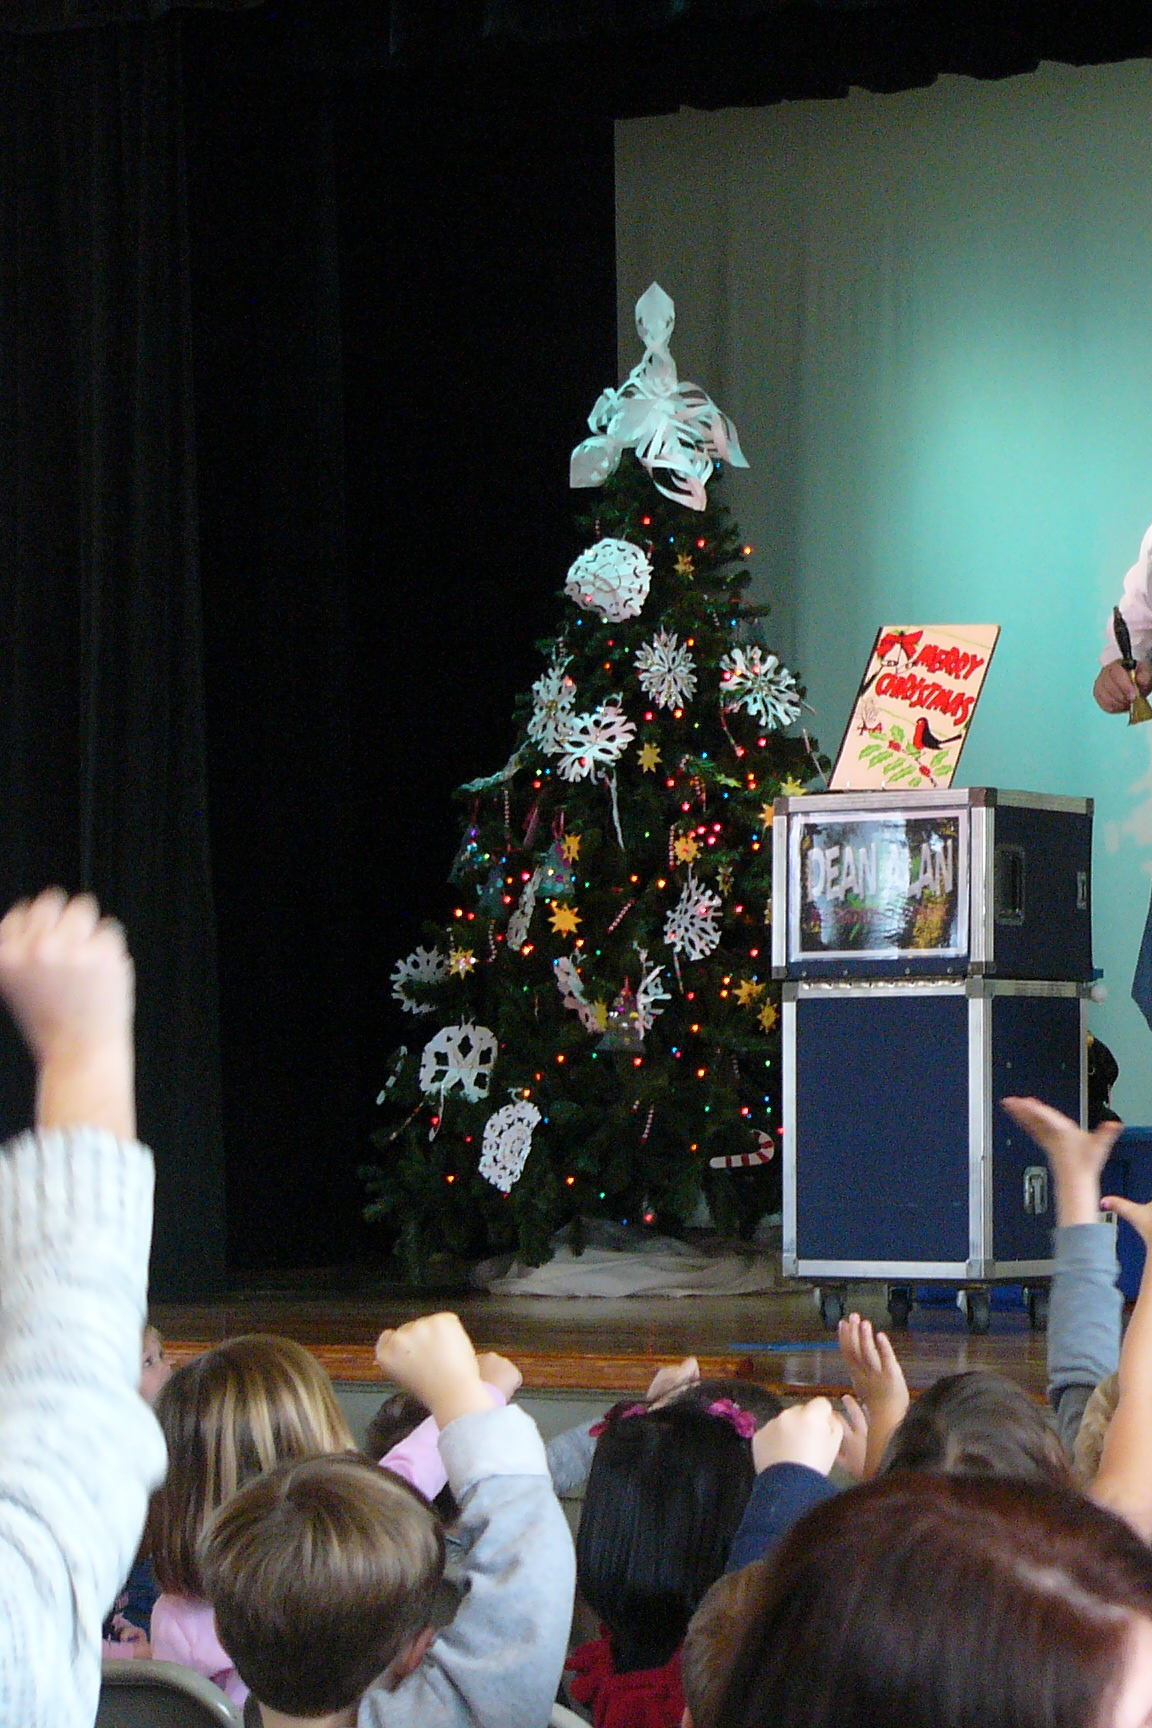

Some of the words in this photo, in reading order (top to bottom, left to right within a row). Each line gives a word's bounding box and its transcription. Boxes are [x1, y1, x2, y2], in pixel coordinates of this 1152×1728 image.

[915, 644, 984, 680] MERRY
[875, 673, 975, 726] CHRISTMAS
[806, 842, 877, 902] DEAN
